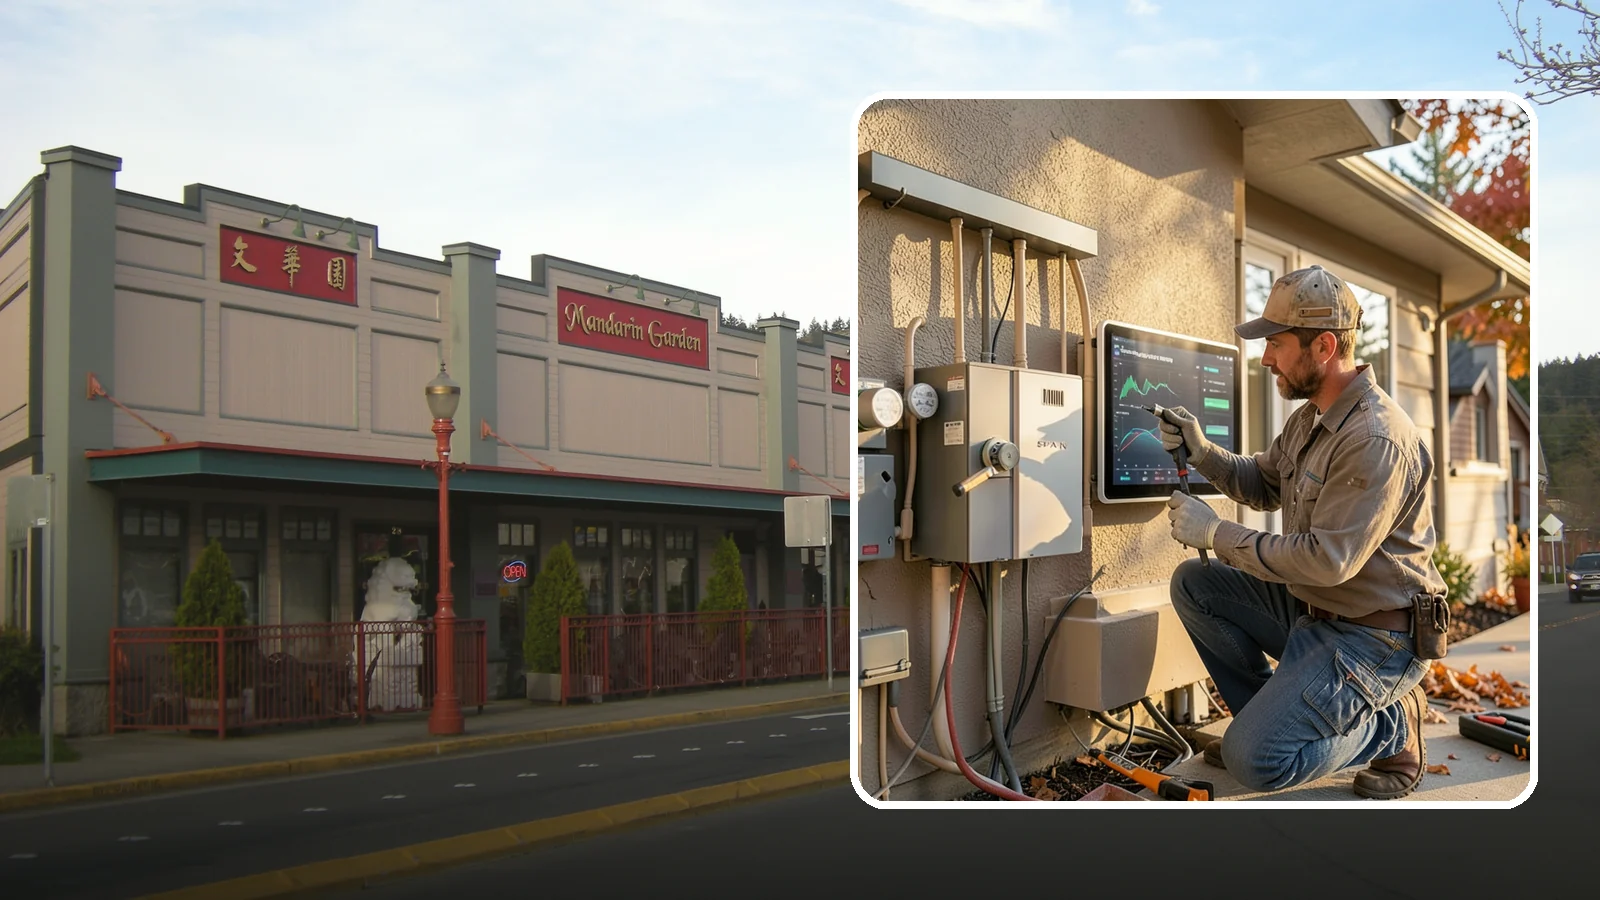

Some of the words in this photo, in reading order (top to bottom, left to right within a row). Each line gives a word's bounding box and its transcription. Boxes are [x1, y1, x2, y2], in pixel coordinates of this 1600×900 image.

[231, 235, 347, 290] 文華園
[564, 302, 645, 341] Mandarin
[648, 320, 702, 352] Garden
[1036, 440, 1067, 450] SPAN
[503, 565, 526, 578] OPEN
